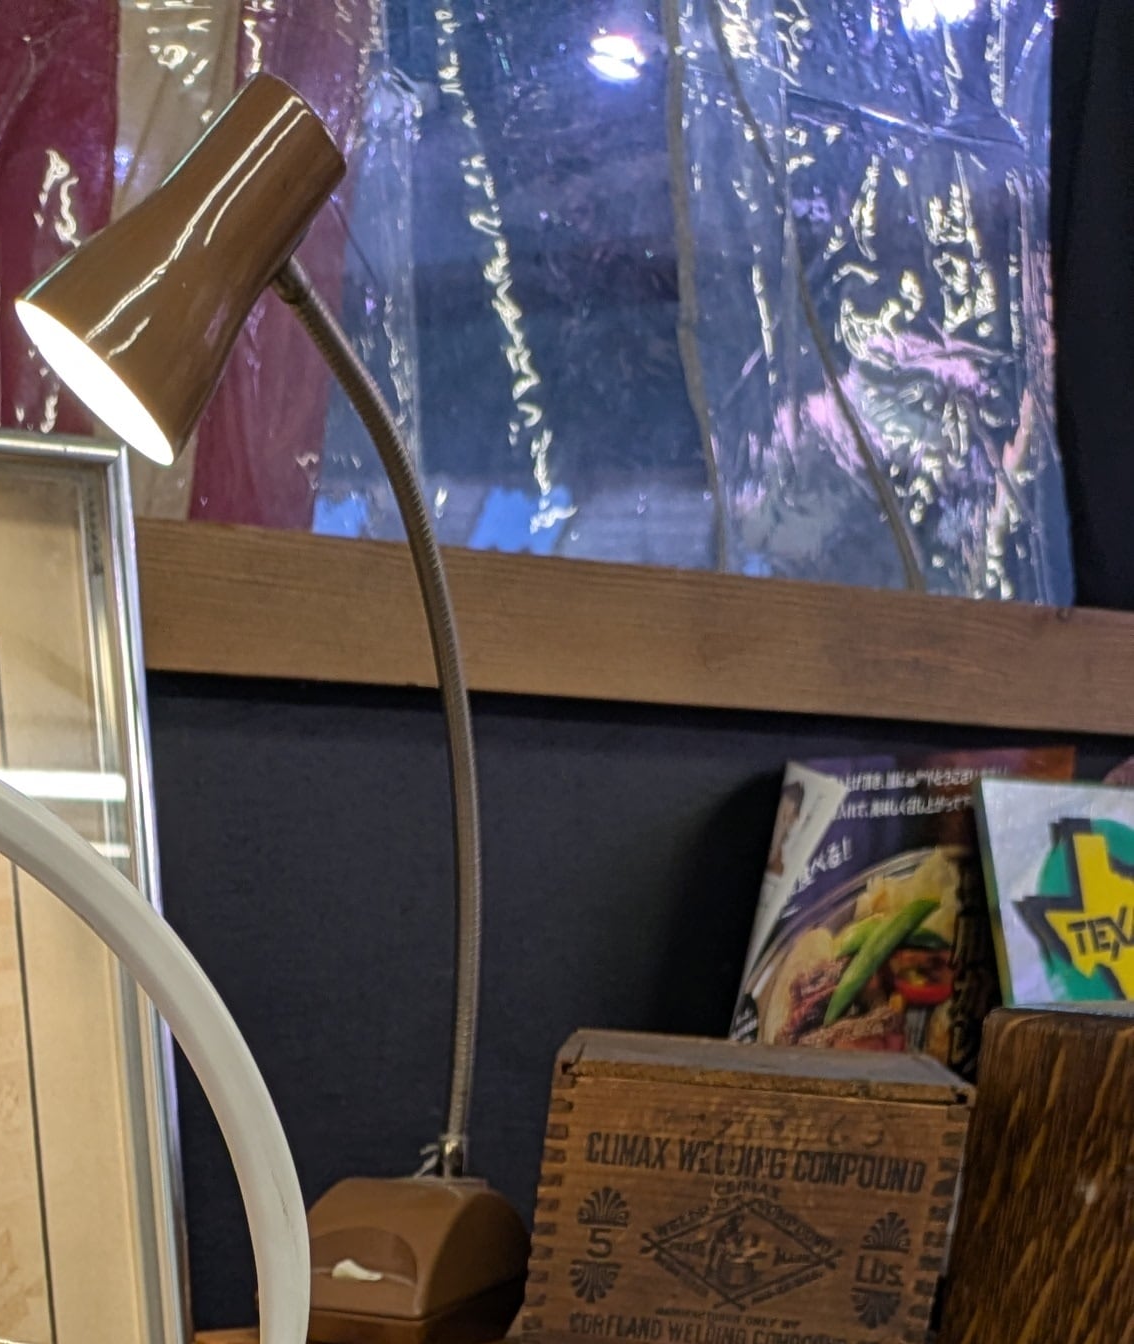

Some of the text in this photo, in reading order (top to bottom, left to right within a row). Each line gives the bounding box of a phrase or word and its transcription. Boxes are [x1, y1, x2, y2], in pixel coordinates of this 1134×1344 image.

[1067, 903, 1134, 962] TEX
[585, 1130, 670, 1171] CLIMAX
[791, 1150, 927, 1194] COMPOUND
[587, 1228, 614, 1259] 5
